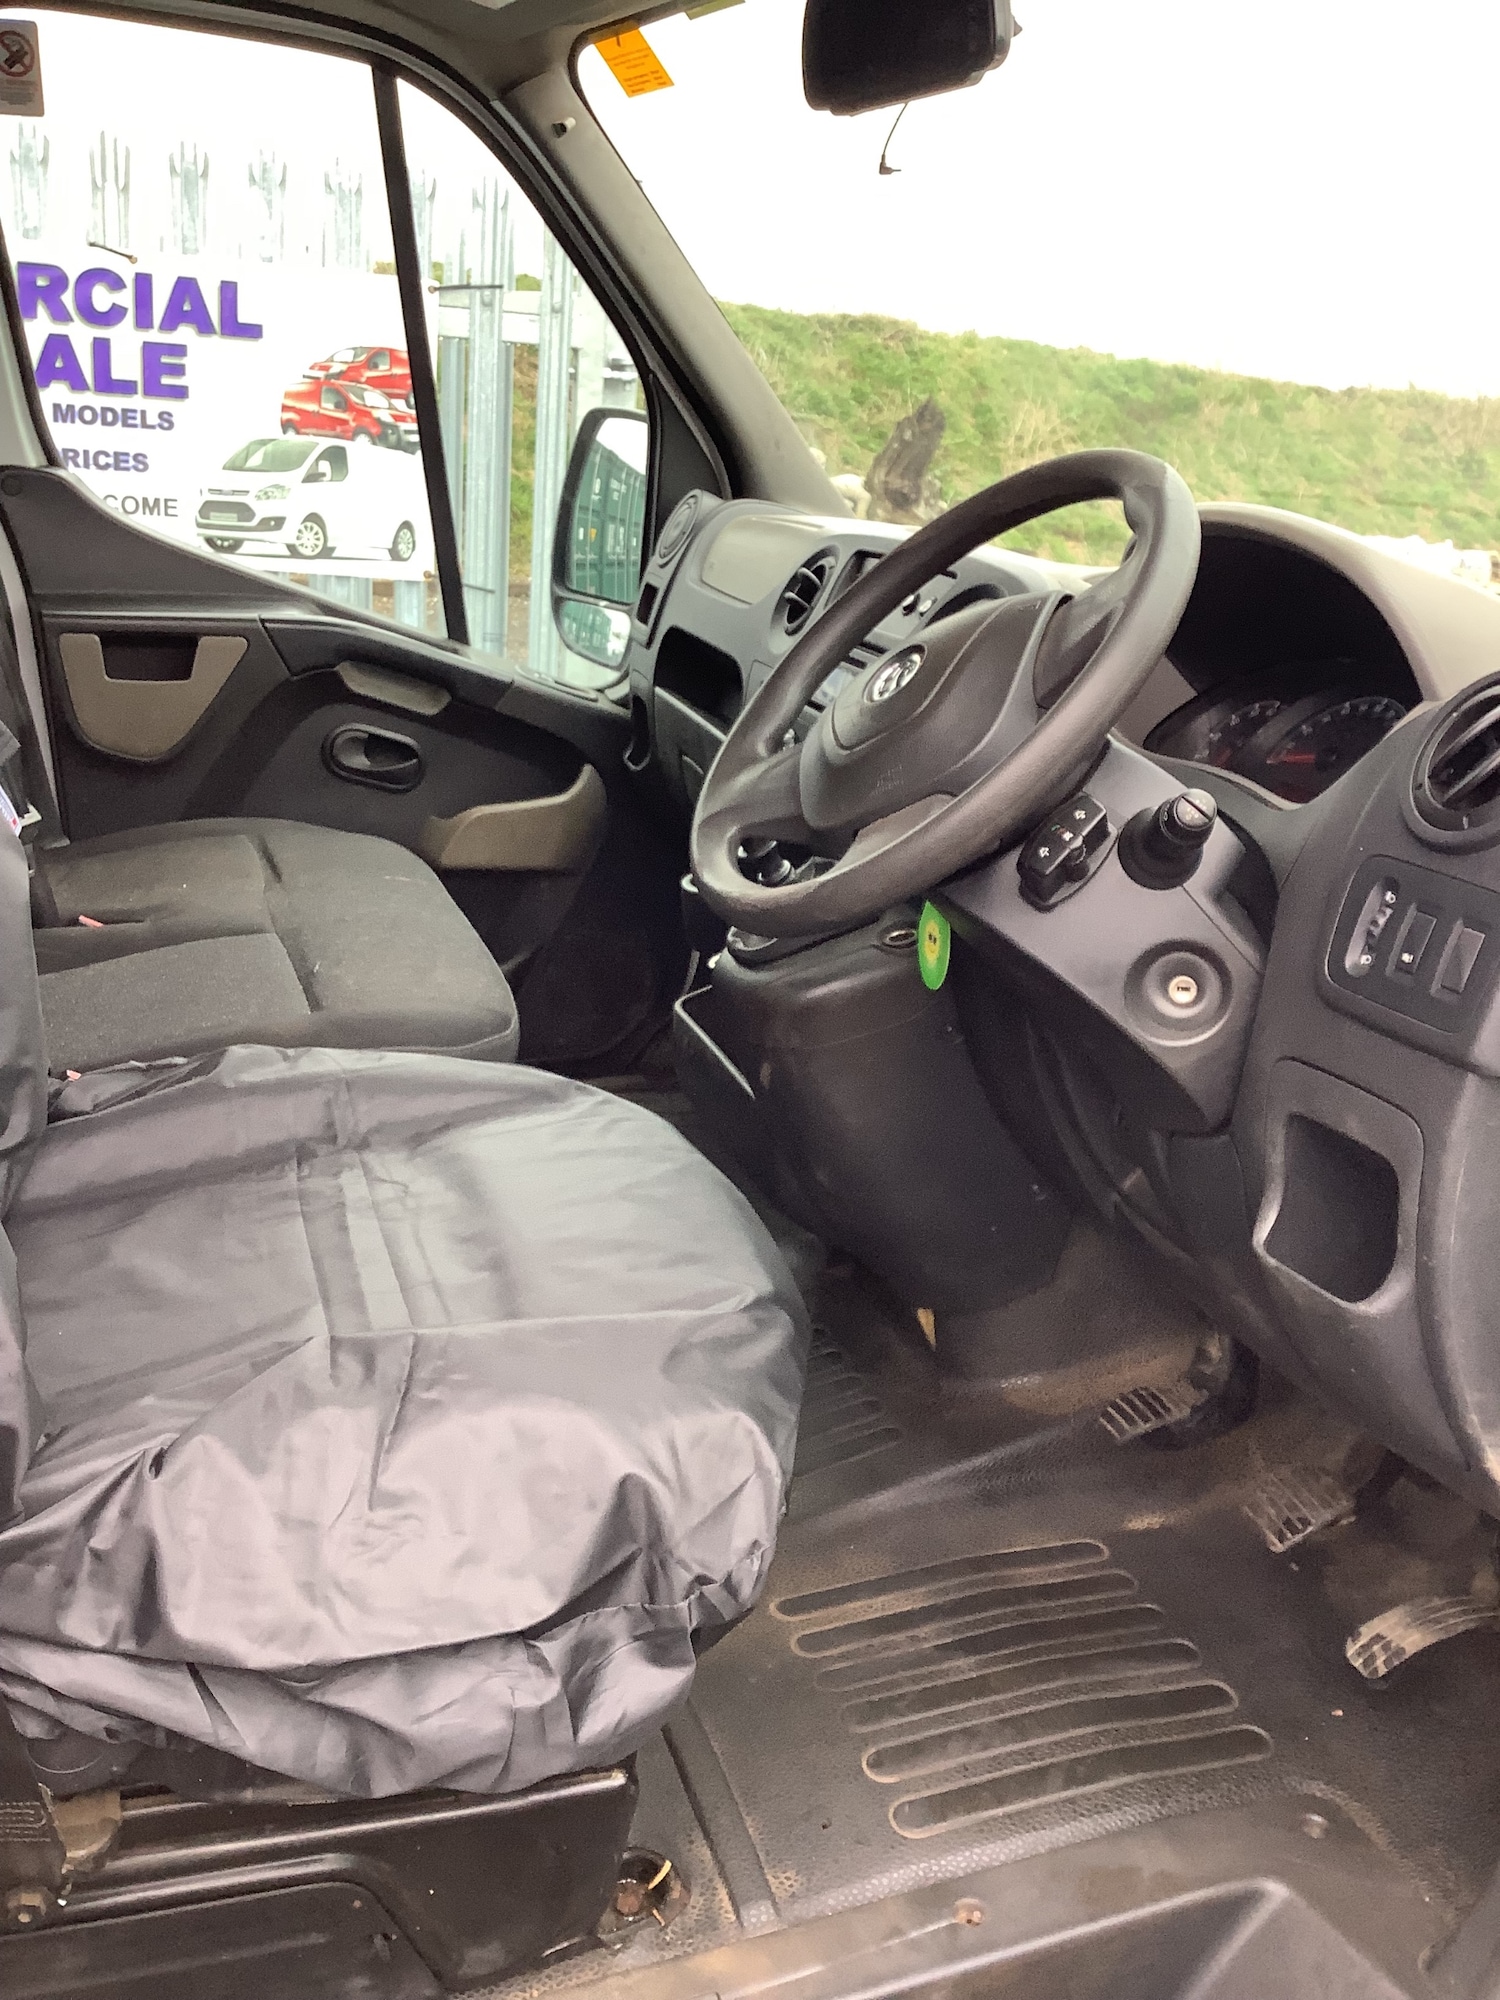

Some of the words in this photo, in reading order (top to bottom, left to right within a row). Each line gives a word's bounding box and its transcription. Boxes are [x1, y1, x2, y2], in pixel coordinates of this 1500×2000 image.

[17, 261, 263, 339] RCIAL
[35, 333, 189, 400] ALE
[52, 402, 175, 431] MODELS
[61, 447, 149, 473] RICES
